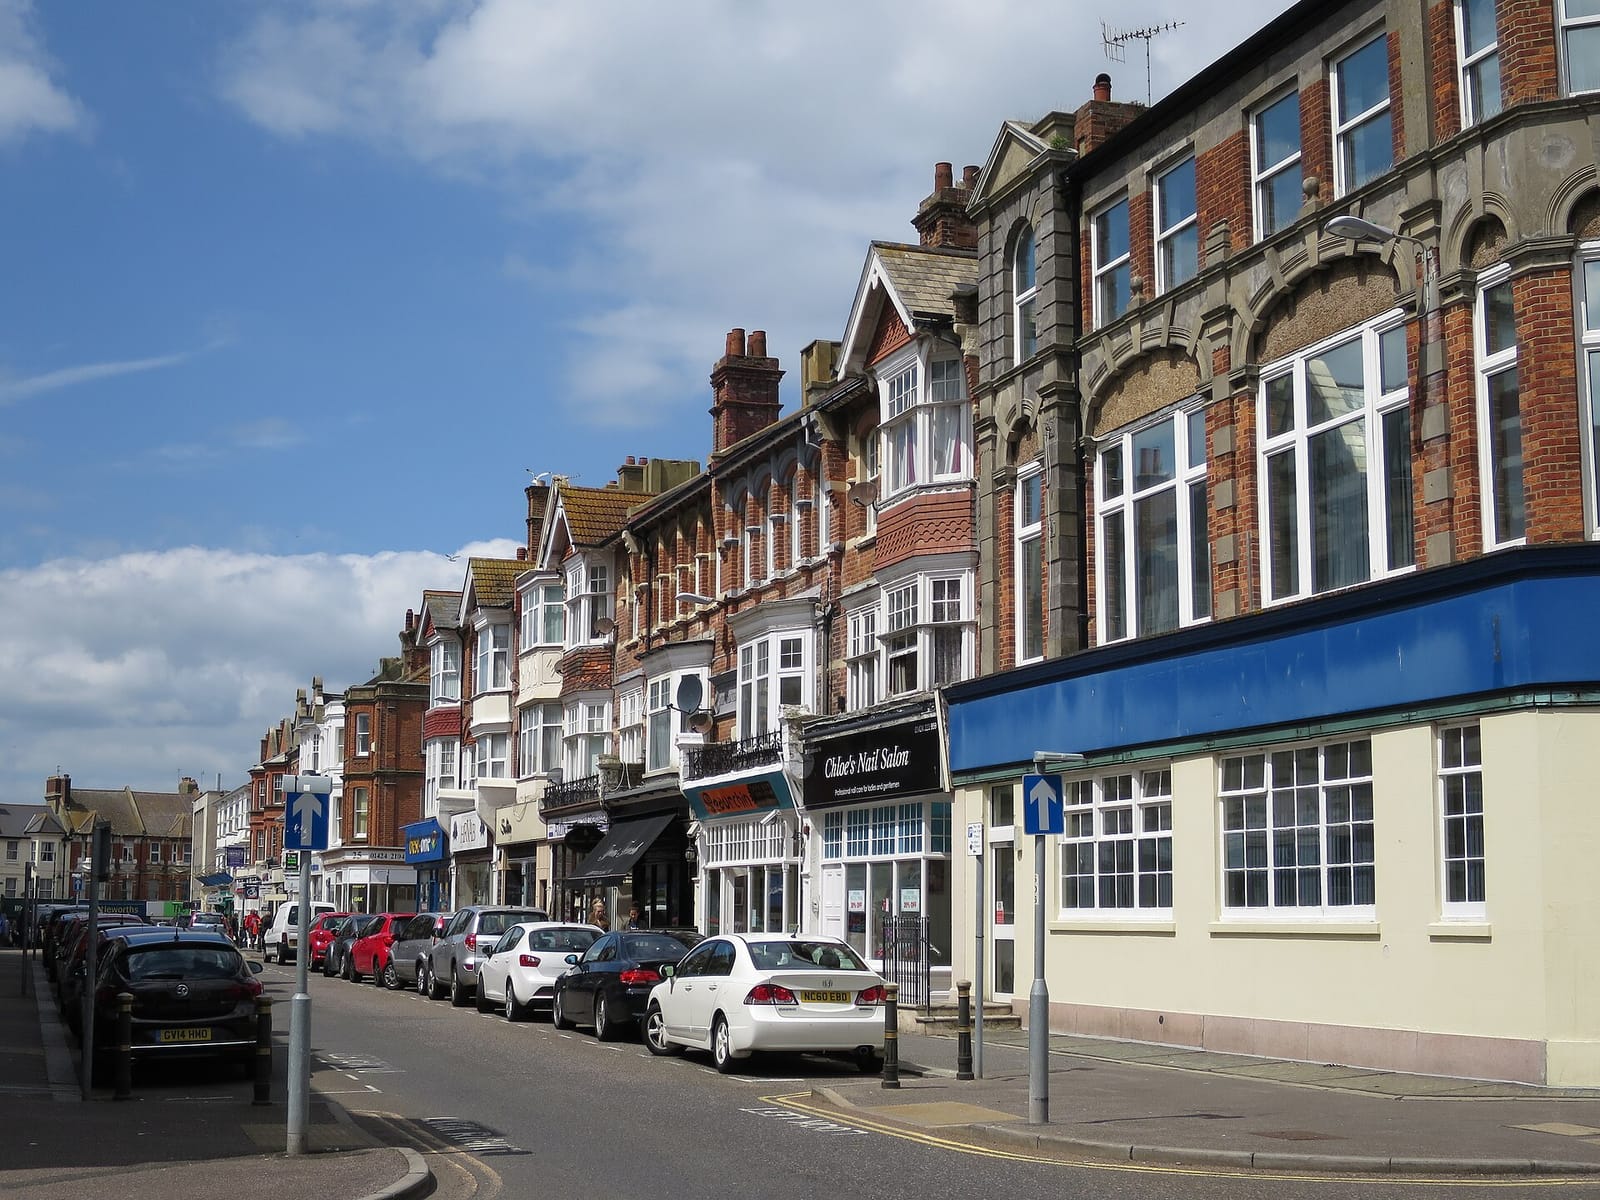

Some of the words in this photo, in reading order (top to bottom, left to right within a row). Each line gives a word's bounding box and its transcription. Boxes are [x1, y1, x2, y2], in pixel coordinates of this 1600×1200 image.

[824, 754, 856, 778] Chloe's
[857, 748, 880, 774] Nail
[880, 745, 910, 770] Salon
[883, 781, 900, 792] gentlemen
[804, 991, 828, 1001] NC60
[164, 1030, 186, 1040] GV14
